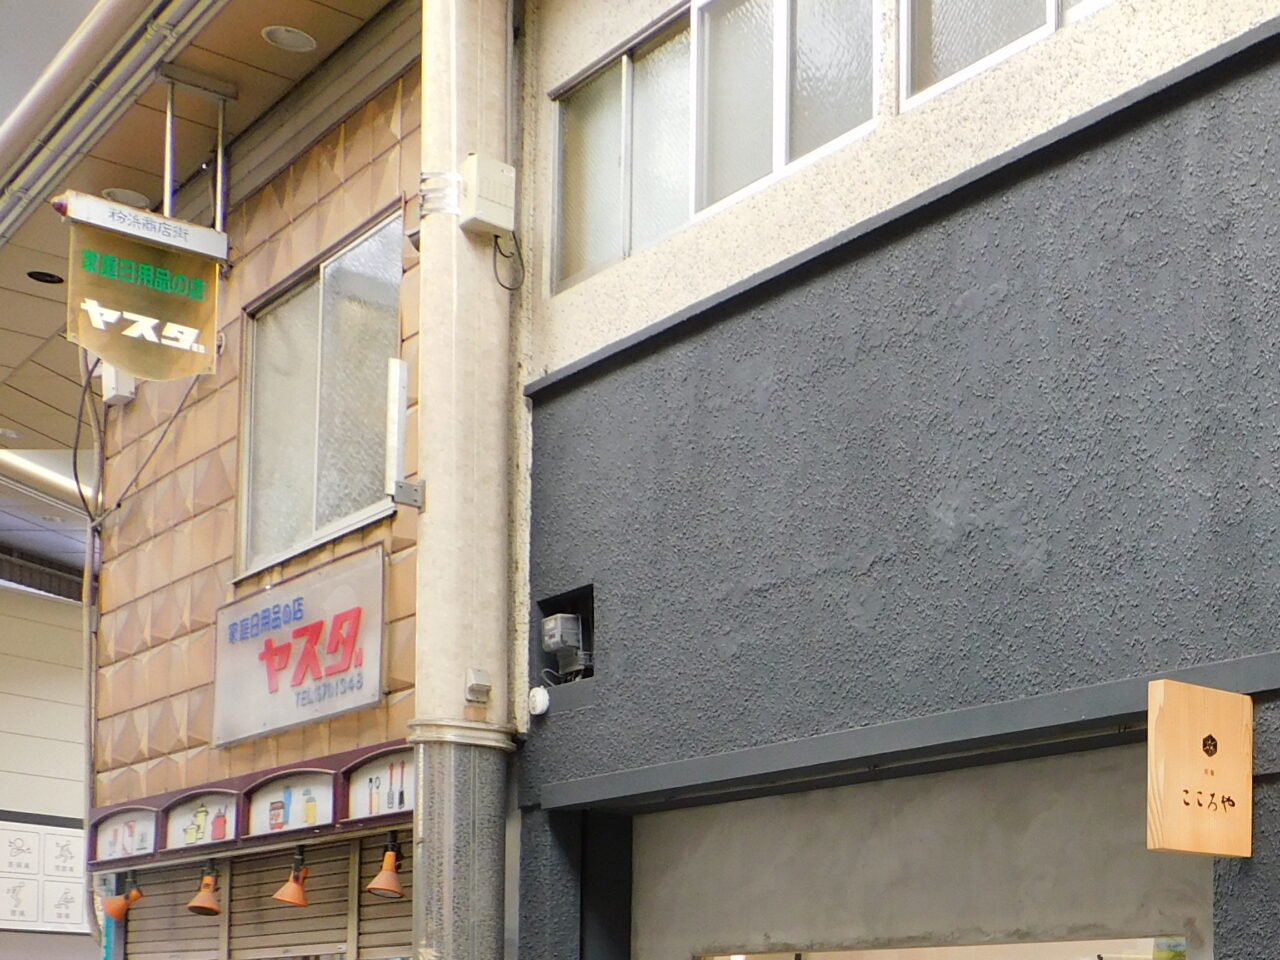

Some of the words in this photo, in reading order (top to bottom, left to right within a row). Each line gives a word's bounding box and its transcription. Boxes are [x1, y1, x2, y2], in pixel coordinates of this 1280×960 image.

[81, 249, 205, 301] 家庭日用品の店
[228, 597, 304, 644] 家庭日用品の店
[1182, 789, 1235, 812] こころや
